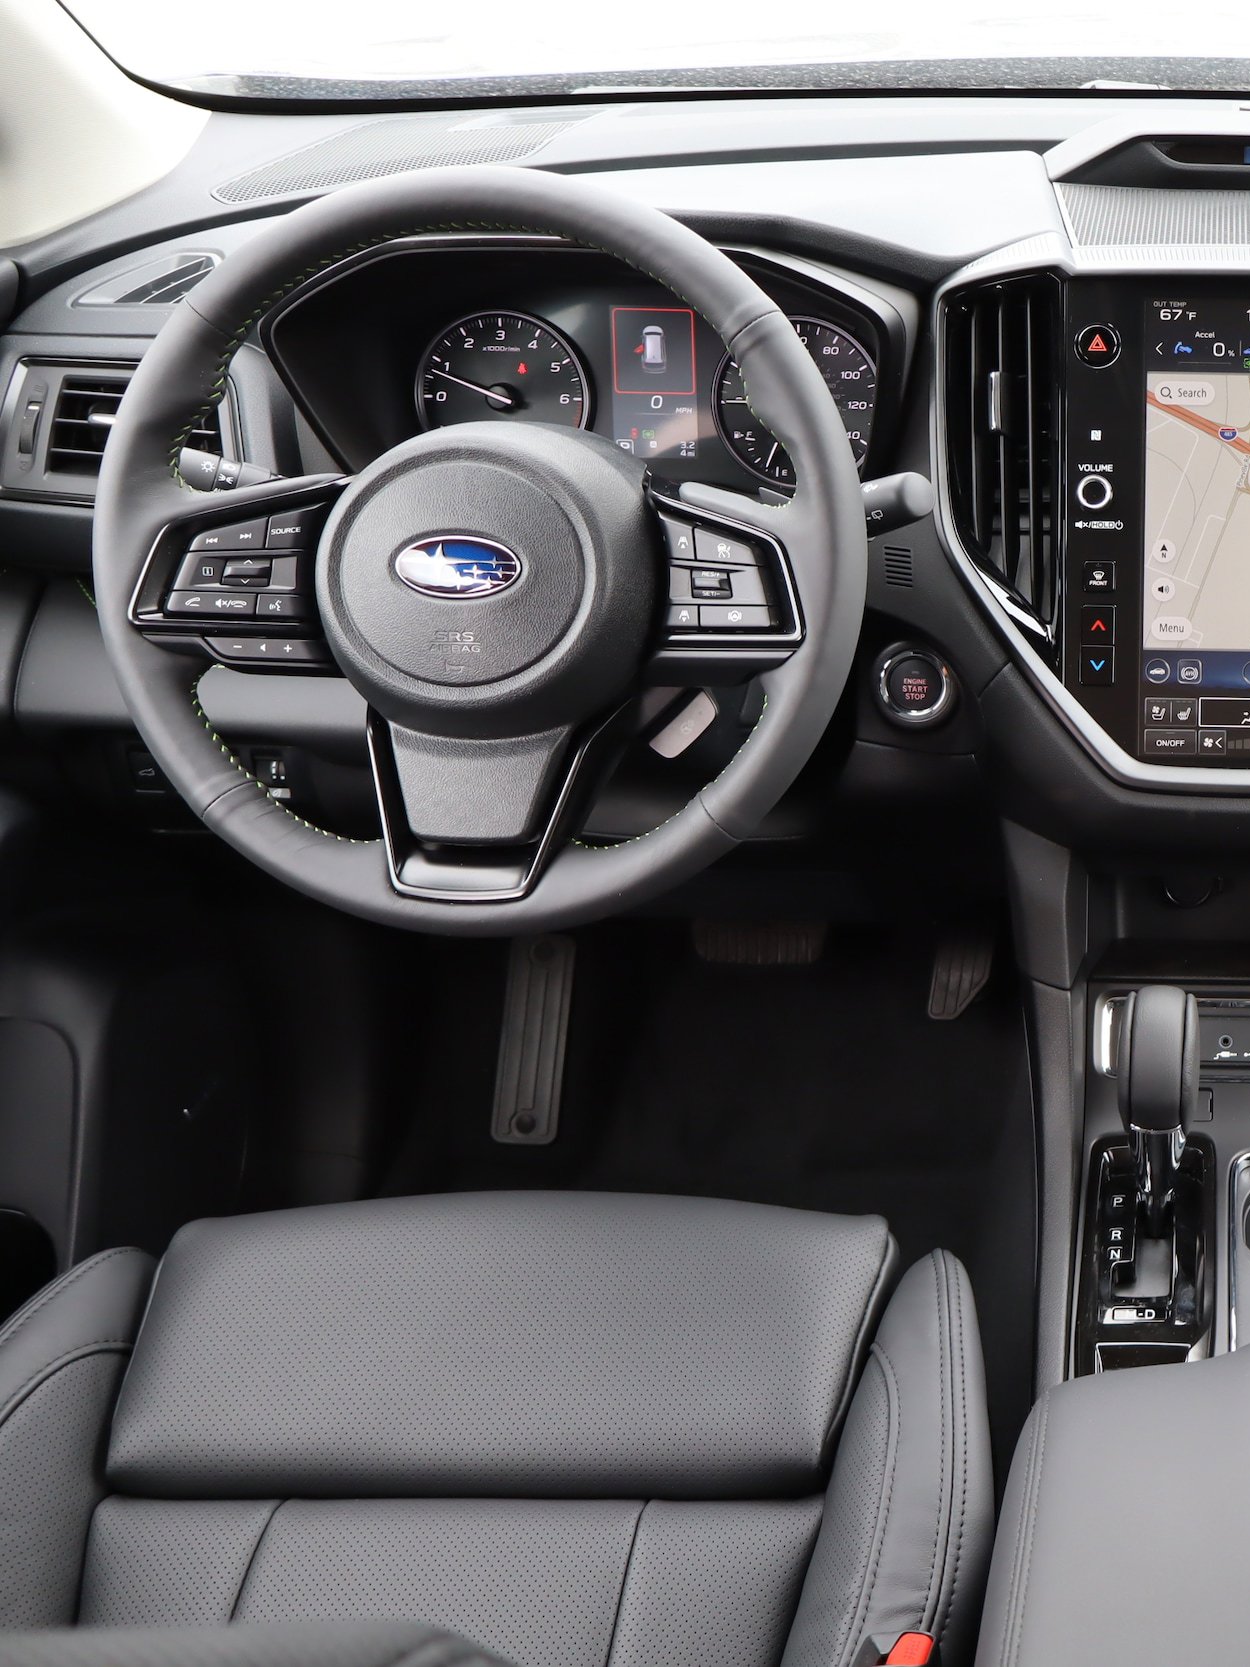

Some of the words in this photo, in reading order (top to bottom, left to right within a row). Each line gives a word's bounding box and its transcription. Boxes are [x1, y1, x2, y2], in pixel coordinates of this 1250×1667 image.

[1159, 308, 1183, 321] 67
[495, 330, 506, 341] 3
[1194, 331, 1215, 339] Accel
[463, 338, 475, 349] 2
[527, 339, 539, 350] 4
[822, 346, 840, 355] 80
[1212, 342, 1226, 358] 0
[443, 361, 450, 371] 1
[550, 362, 561, 373] 5
[841, 371, 861, 380] 100
[435, 391, 447, 402] 0
[1177, 388, 1207, 398] Search
[559, 393, 570, 404] 6
[650, 395, 663, 409] 0
[847, 401, 867, 410] 120
[846, 431, 861, 440] 40
[680, 441, 695, 449] 3.2
[1078, 463, 1114, 472] VOLUME
[781, 469, 788, 477] E
[1092, 521, 1115, 529] HOLD
[270, 526, 301, 535] SOURCE
[1159, 623, 1185, 633] Menu
[433, 631, 475, 642] SRS
[902, 685, 928, 693] START
[905, 692, 925, 700] STOP
[1156, 739, 1186, 747] ON/OFF
[1112, 1197, 1123, 1208] P
[1111, 1229, 1122, 1241] R
[1110, 1248, 1121, 1260] N
